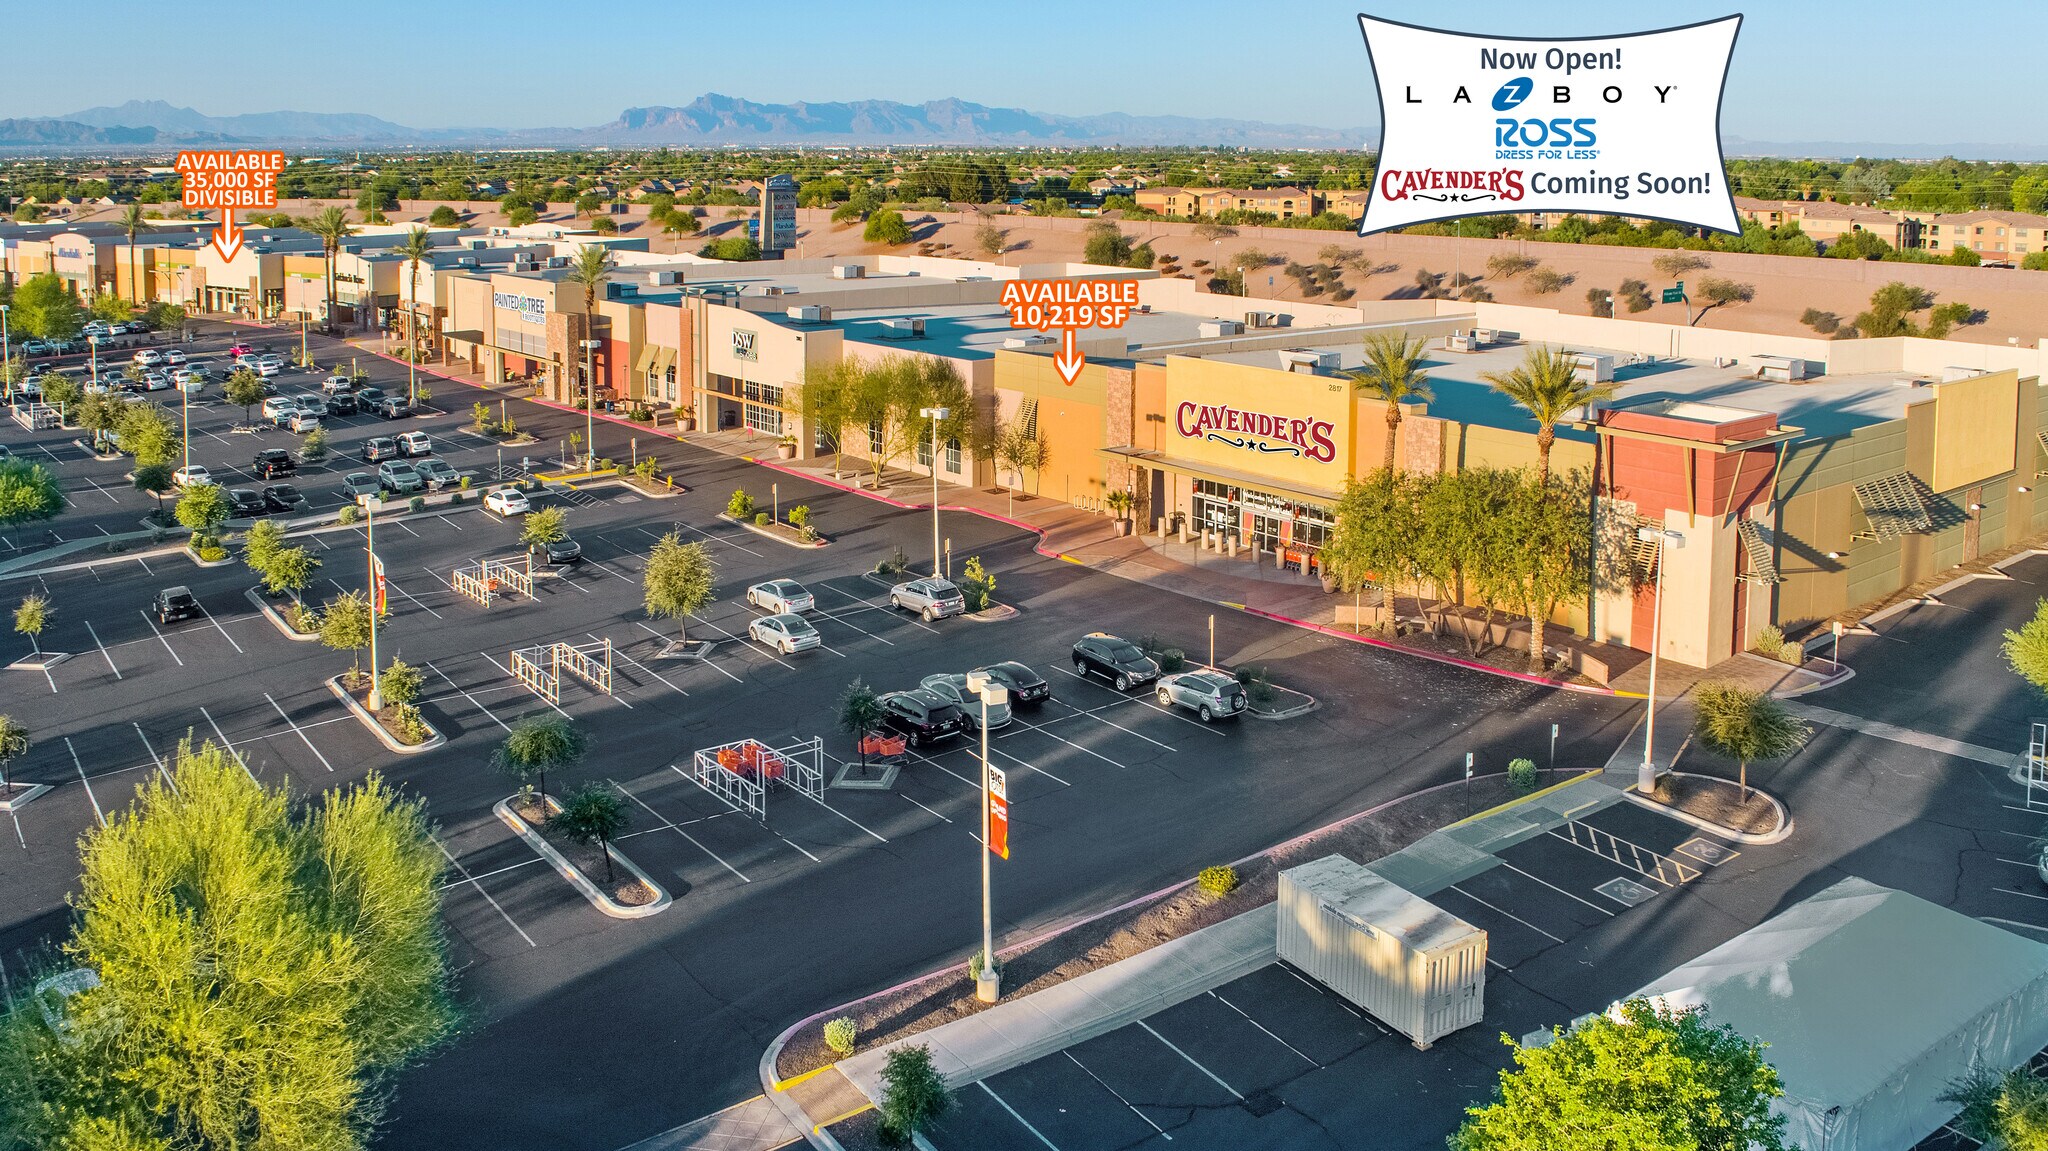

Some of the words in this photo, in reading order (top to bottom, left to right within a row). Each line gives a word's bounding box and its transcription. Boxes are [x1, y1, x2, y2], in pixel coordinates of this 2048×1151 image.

[495, 293, 519, 310] PAINTED
[527, 297, 545, 315] TREE
[732, 331, 754, 349] DSW
[1177, 401, 1336, 463] CAVENDER'S
